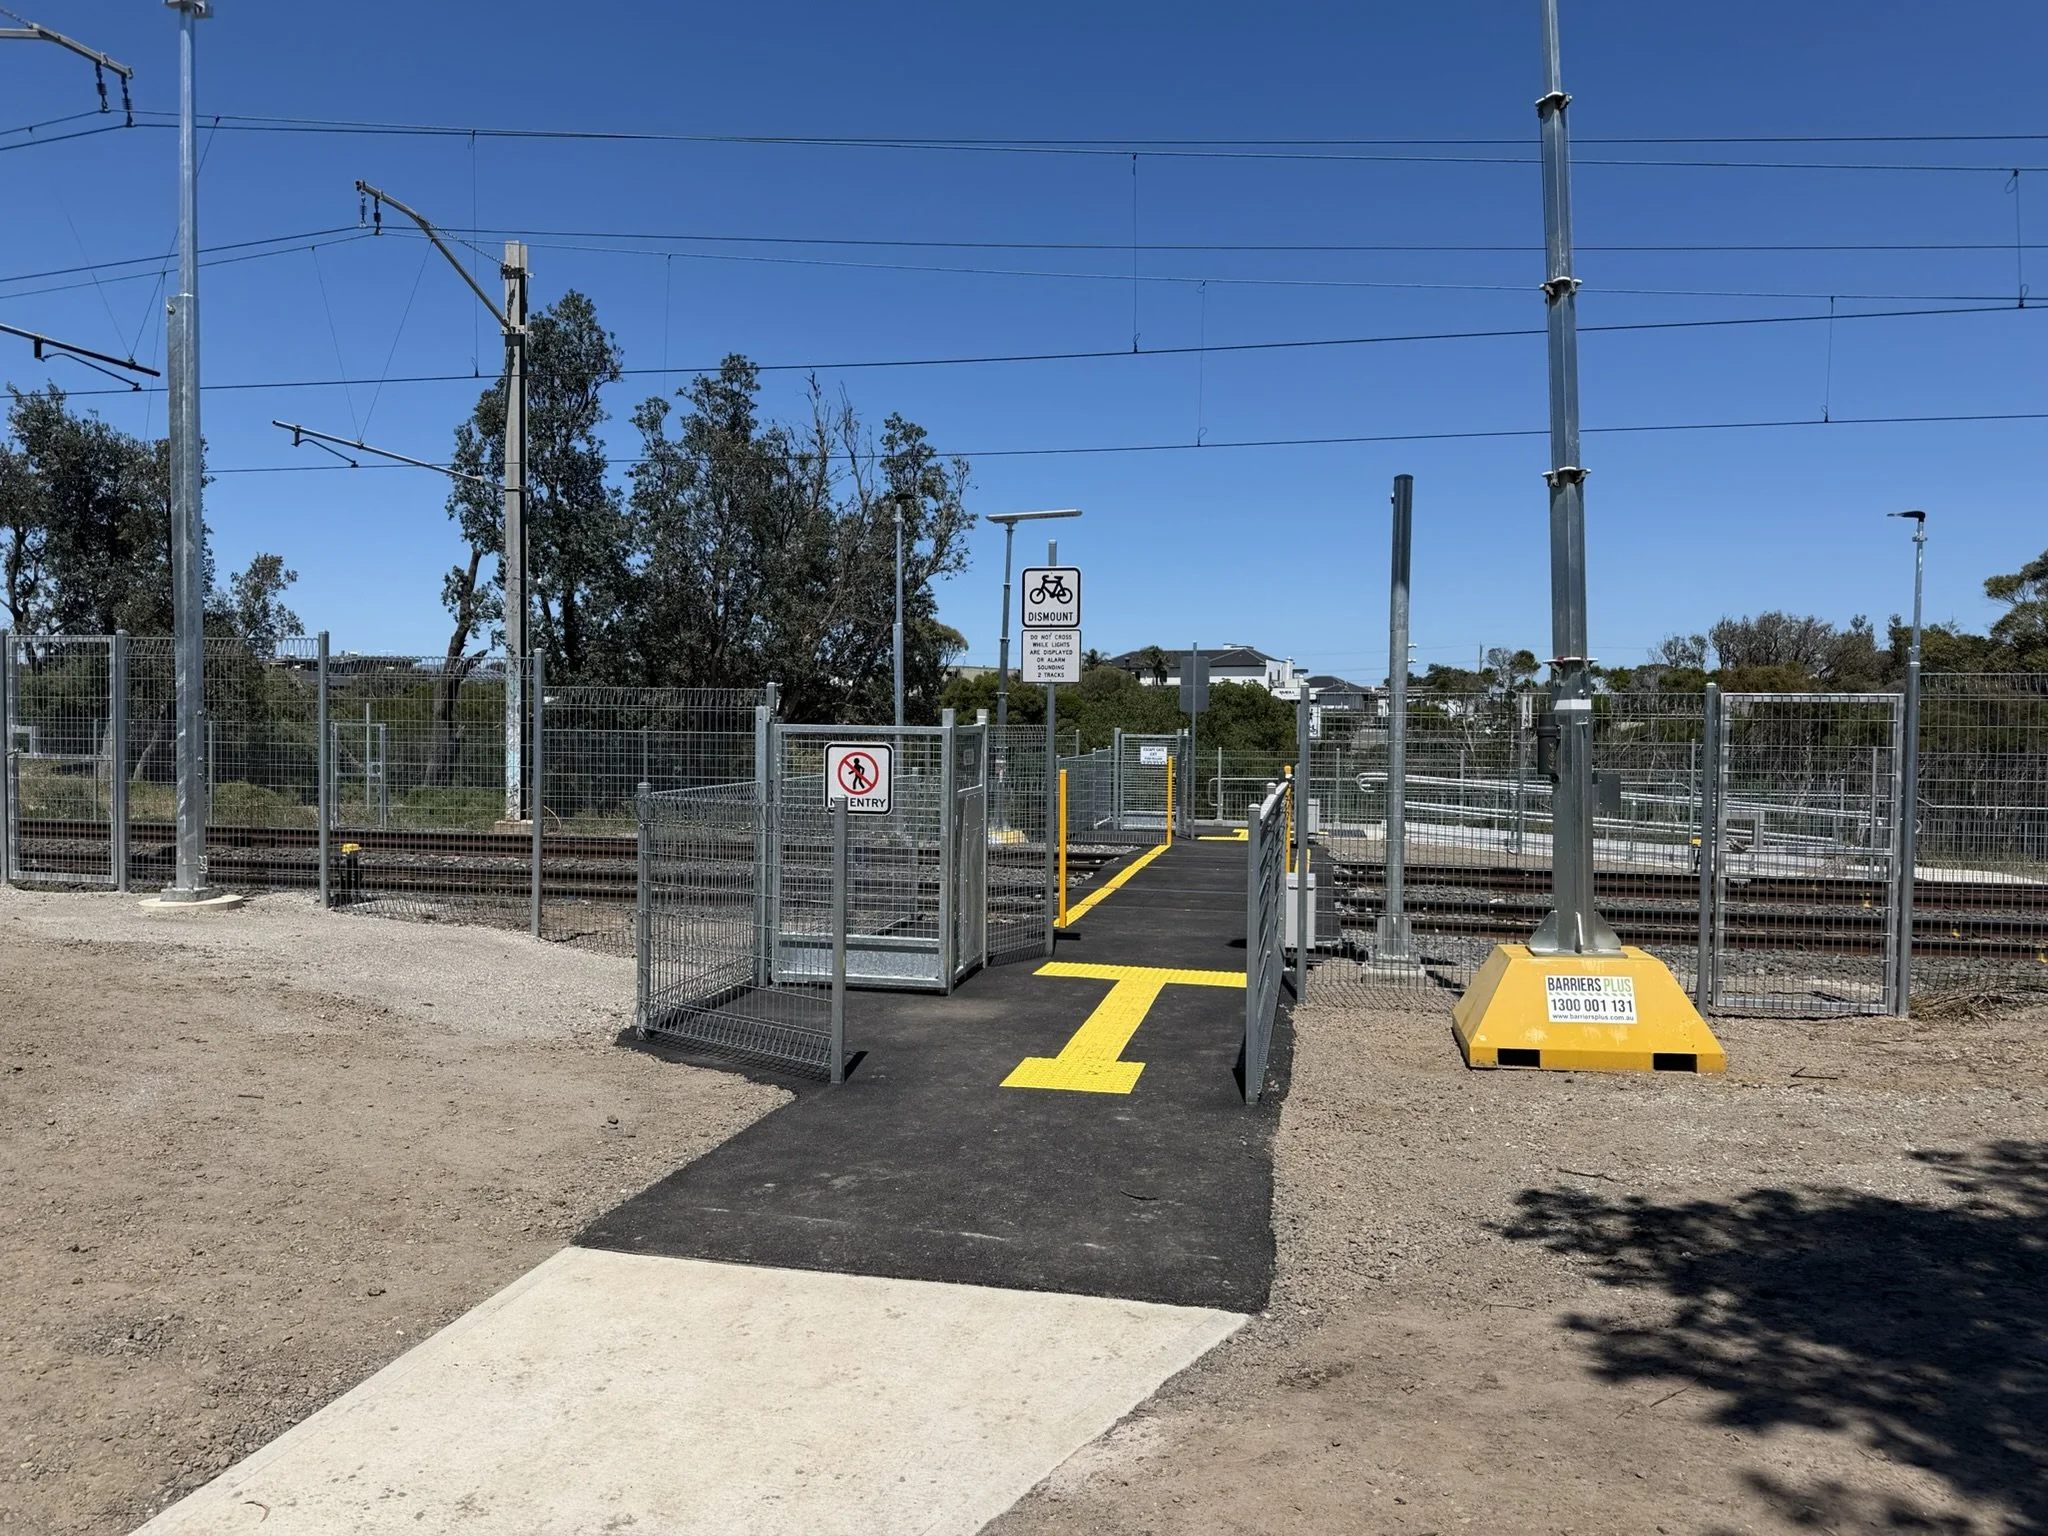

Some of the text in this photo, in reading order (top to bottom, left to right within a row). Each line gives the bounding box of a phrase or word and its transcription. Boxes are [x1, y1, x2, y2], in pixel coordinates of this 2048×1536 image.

[1028, 612, 1074, 622] DISMOUNT
[850, 798, 886, 808] ENTRY
[1547, 977, 1632, 992] BARRIERS PLUS
[1551, 998, 1633, 1013] 1300 001 131
[1552, 1013, 1634, 1021] www.barriersplus.com.au
